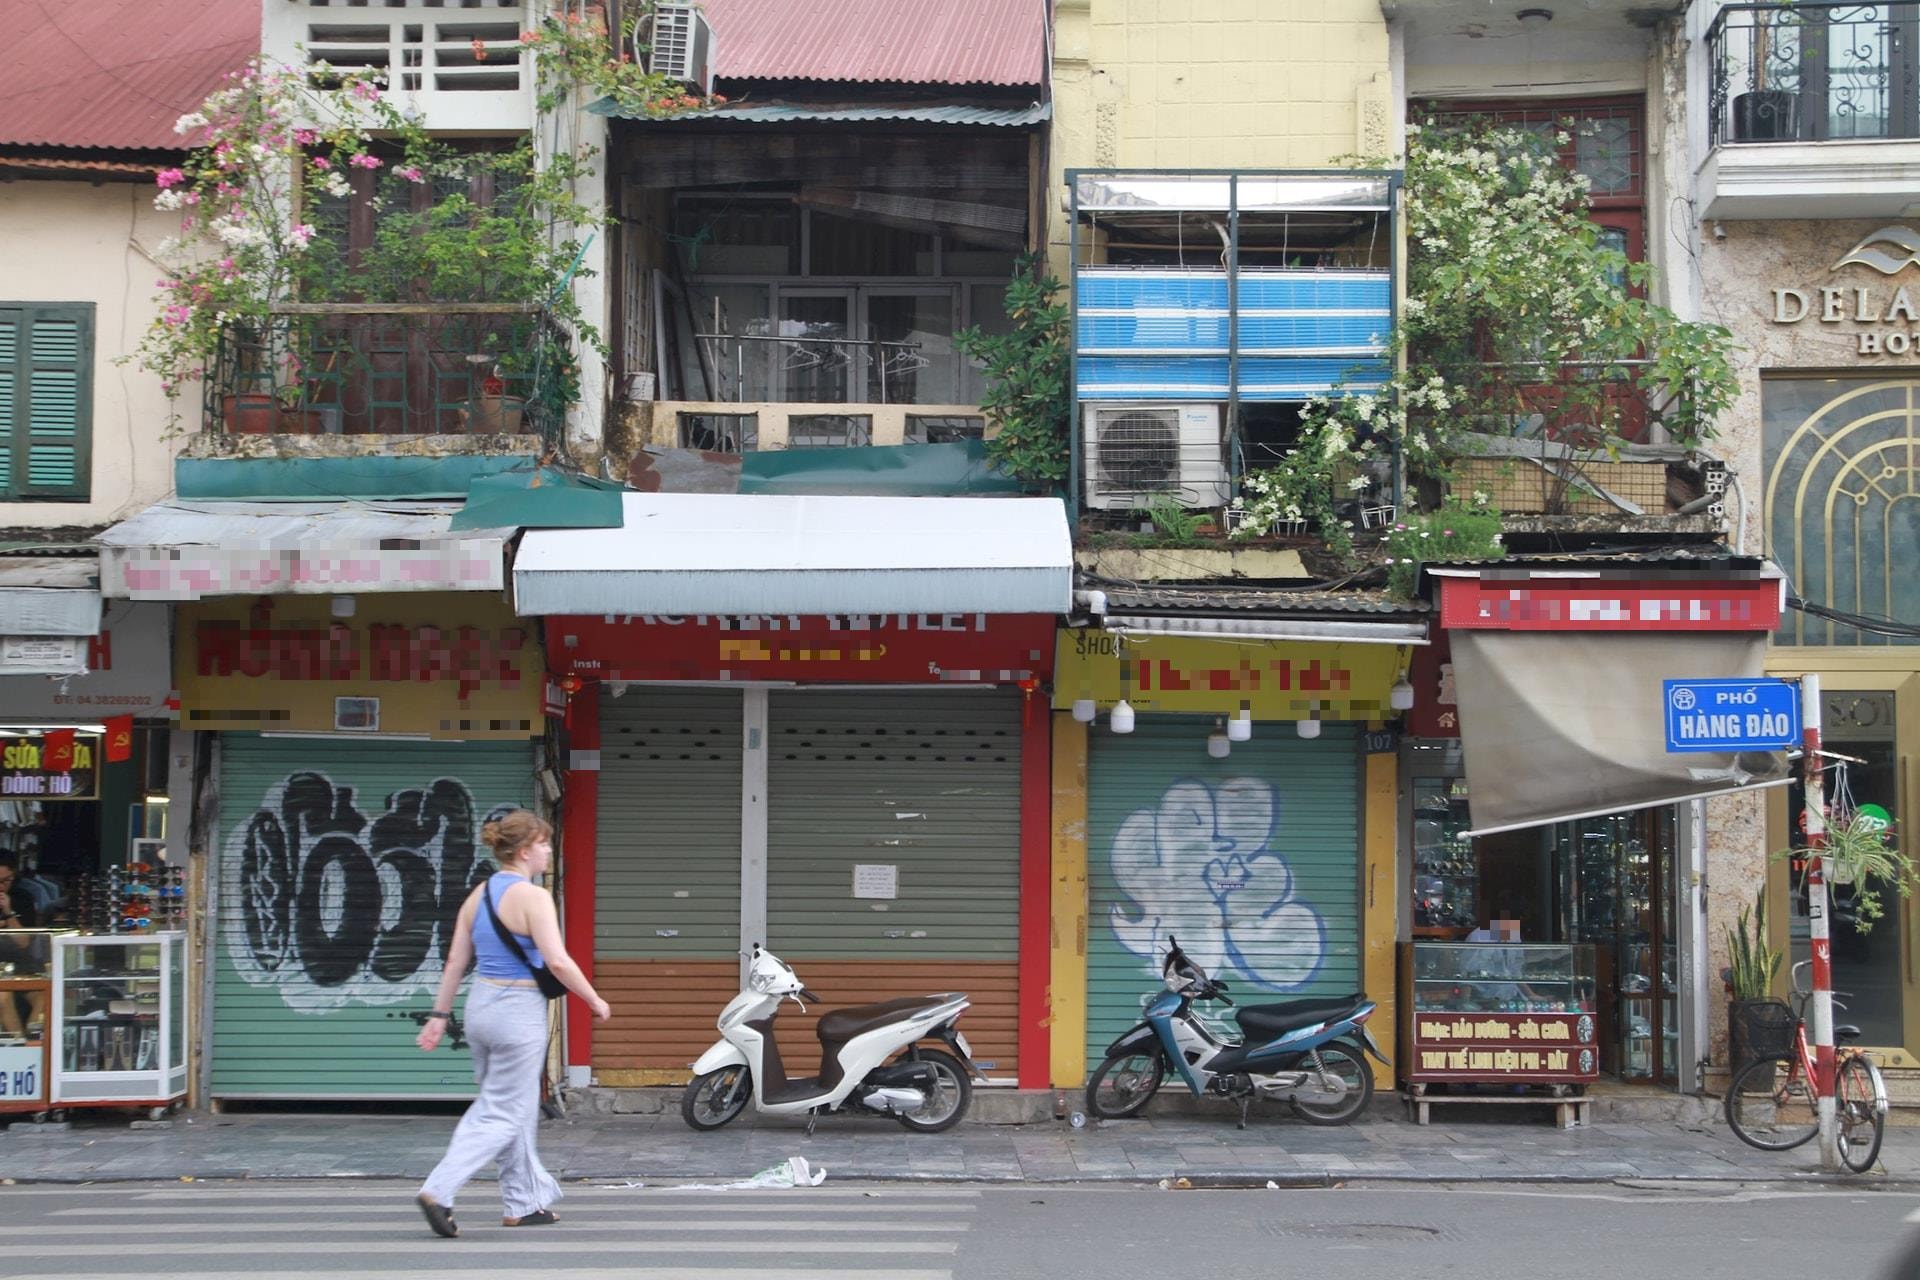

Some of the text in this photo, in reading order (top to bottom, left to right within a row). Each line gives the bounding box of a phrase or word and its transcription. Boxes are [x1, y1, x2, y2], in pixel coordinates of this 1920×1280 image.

[1858, 332, 1920, 354] HO
[1716, 687, 1757, 704] PHỐ
[1680, 708, 1789, 738] HÀNG ĐÀO
[1364, 734, 1392, 750] 107
[3, 738, 40, 769] SỬA
